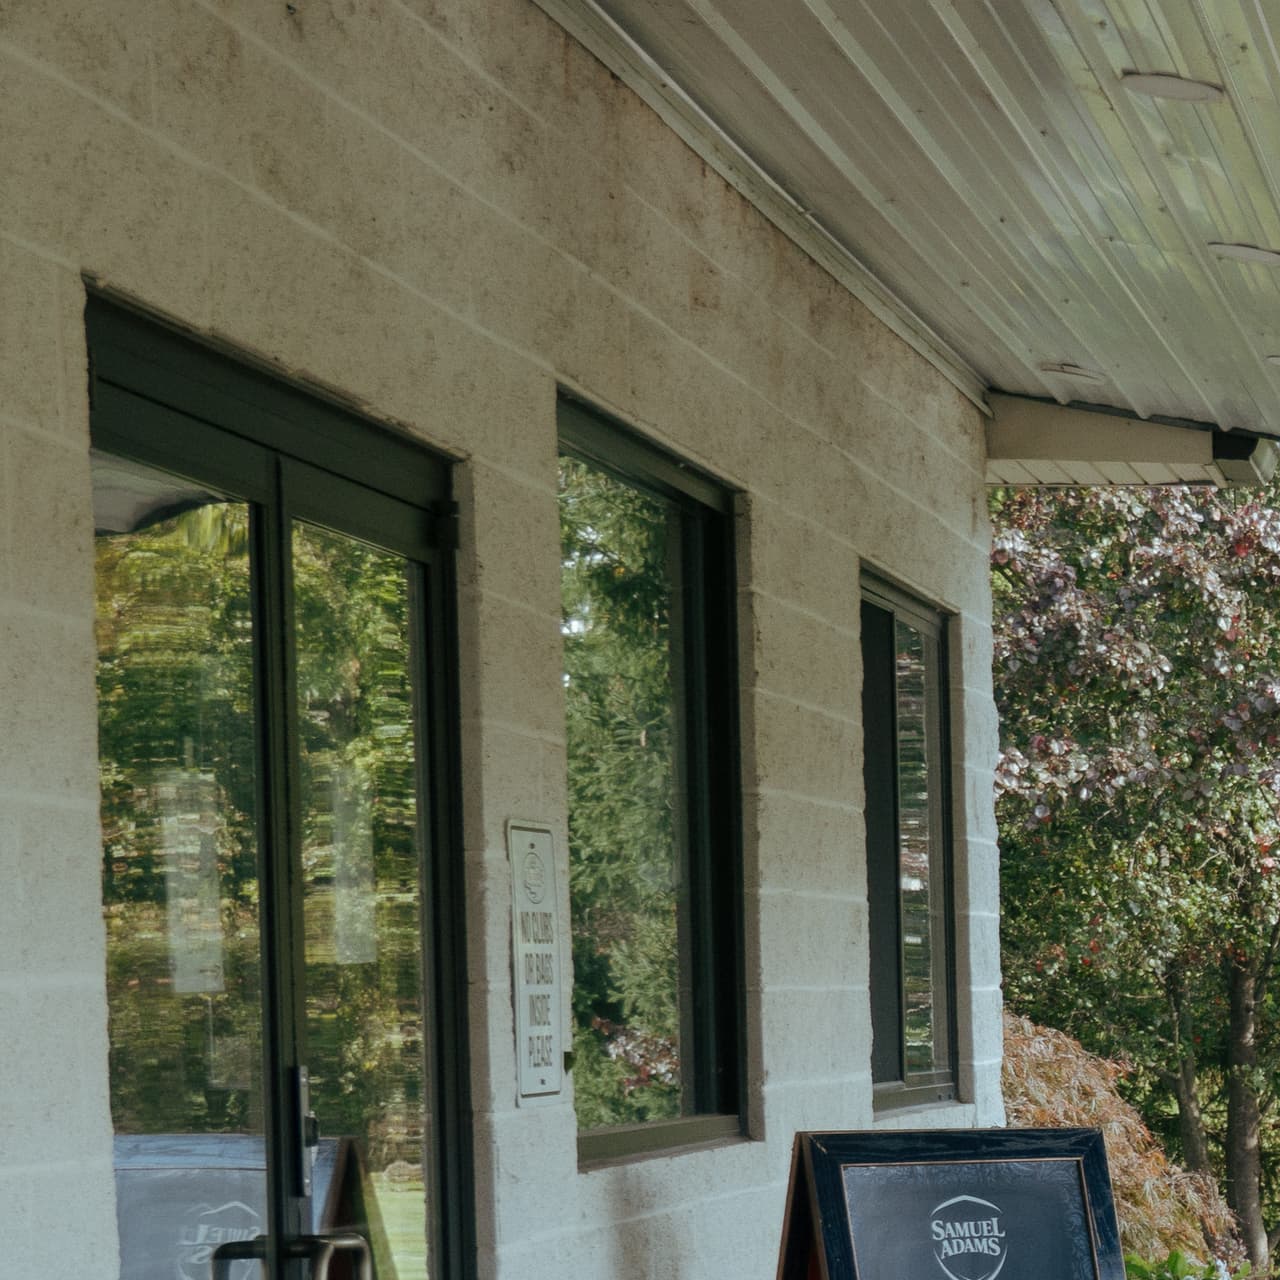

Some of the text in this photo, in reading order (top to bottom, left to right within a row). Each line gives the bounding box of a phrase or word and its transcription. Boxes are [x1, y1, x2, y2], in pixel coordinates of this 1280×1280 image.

[521, 912, 554, 944] NO CLUBS
[525, 953, 553, 985] OR BAGS
[529, 994, 552, 1026] INSIDE
[528, 1035, 553, 1068] PLEASE
[931, 1217, 1006, 1241] SAMUEL
[940, 1237, 1001, 1260] ADAMS
